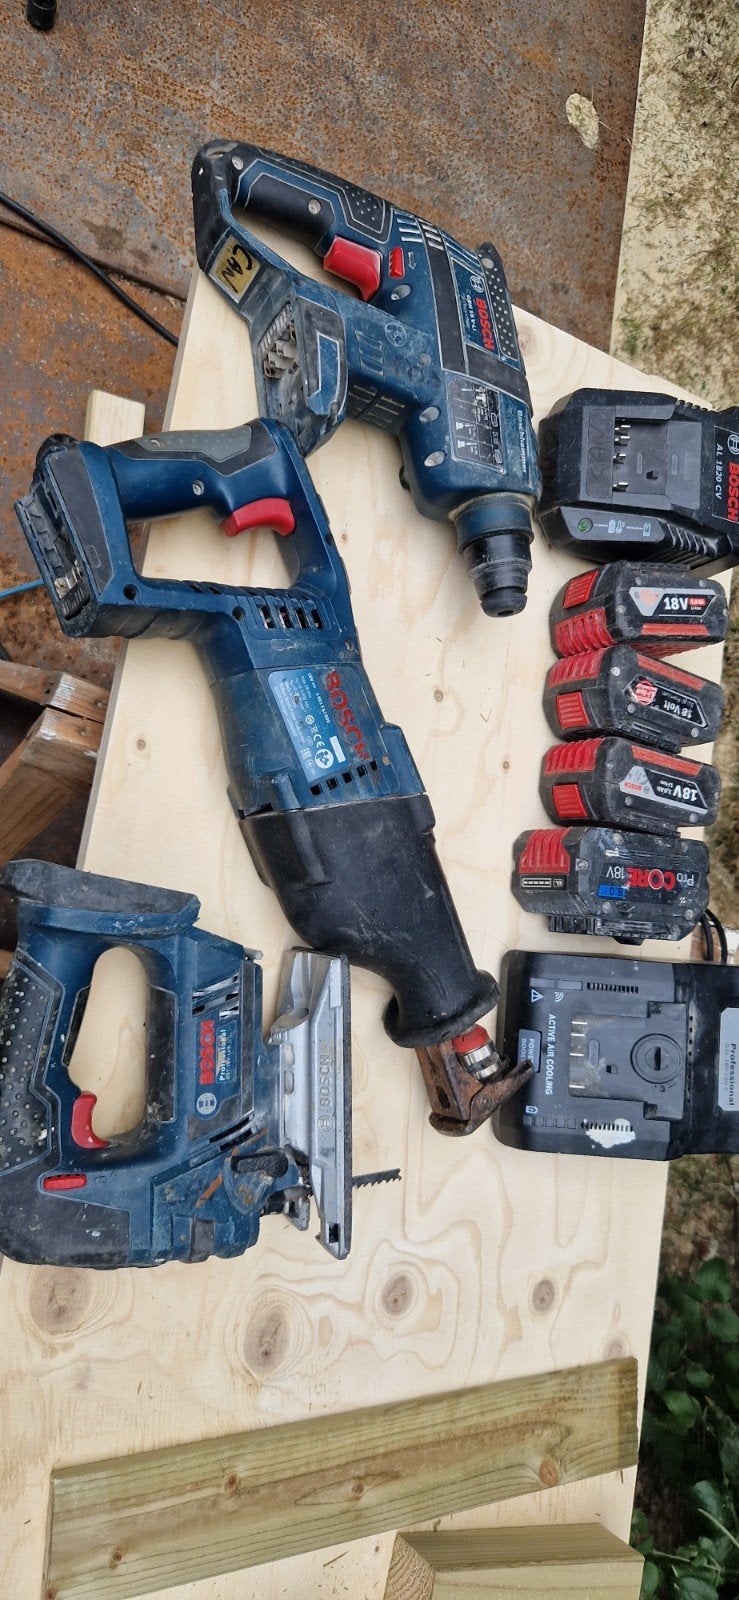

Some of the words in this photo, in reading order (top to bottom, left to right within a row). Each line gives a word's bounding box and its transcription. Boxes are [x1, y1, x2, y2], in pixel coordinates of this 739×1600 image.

[475, 297, 495, 350] BOSCH
[715, 443, 723, 456] AL
[714, 460, 723, 483] 1820
[714, 484, 722, 499] CV
[727, 461, 739, 522] BOSCH
[663, 596, 689, 611] 18V
[325, 670, 370, 760] BOSCH
[663, 700, 680, 715] Volt
[680, 707, 693, 719] 18
[673, 784, 698, 802] 18V
[547, 1013, 556, 1042] ACTIVE
[199, 1020, 215, 1085] BOSCH
[547, 1044, 555, 1057] AIR
[320, 1054, 332, 1107] BOSCH
[545, 1059, 554, 1095] COOLING
[729, 1043, 737, 1106] Professional
